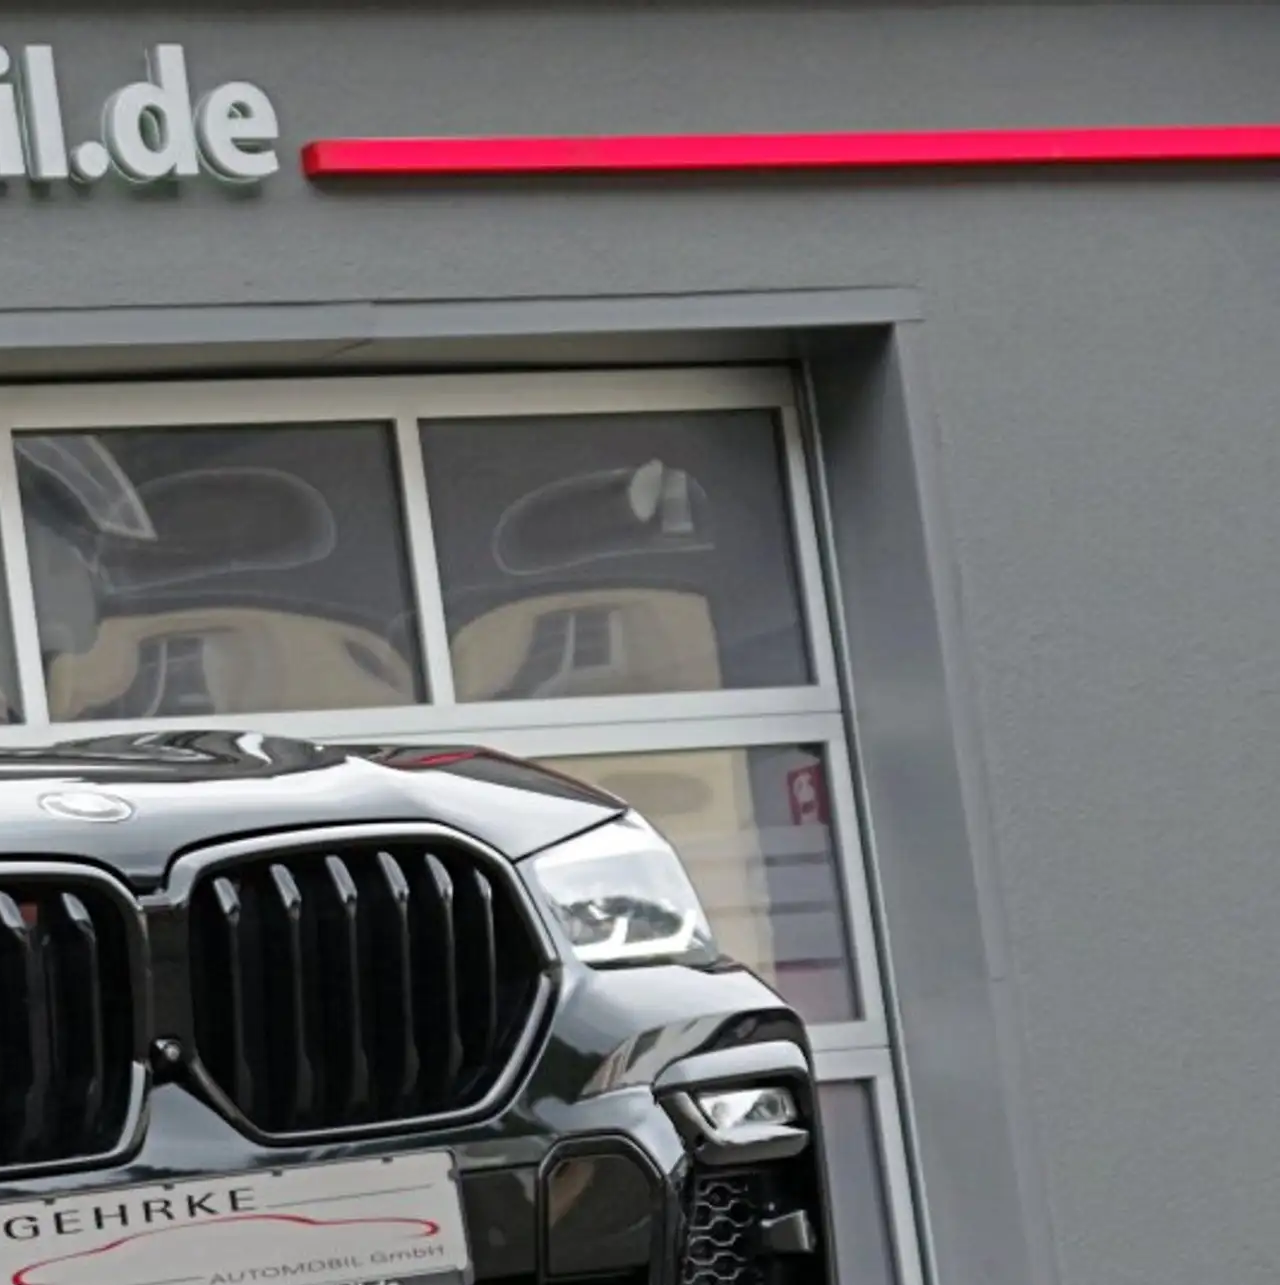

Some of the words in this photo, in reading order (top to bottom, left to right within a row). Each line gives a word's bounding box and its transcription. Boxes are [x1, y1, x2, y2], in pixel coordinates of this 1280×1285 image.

[4, 1187, 256, 1240] GEHRKE
[210, 1257, 364, 1285] AUTOMOBIL
[370, 1244, 445, 1266] GmbH
